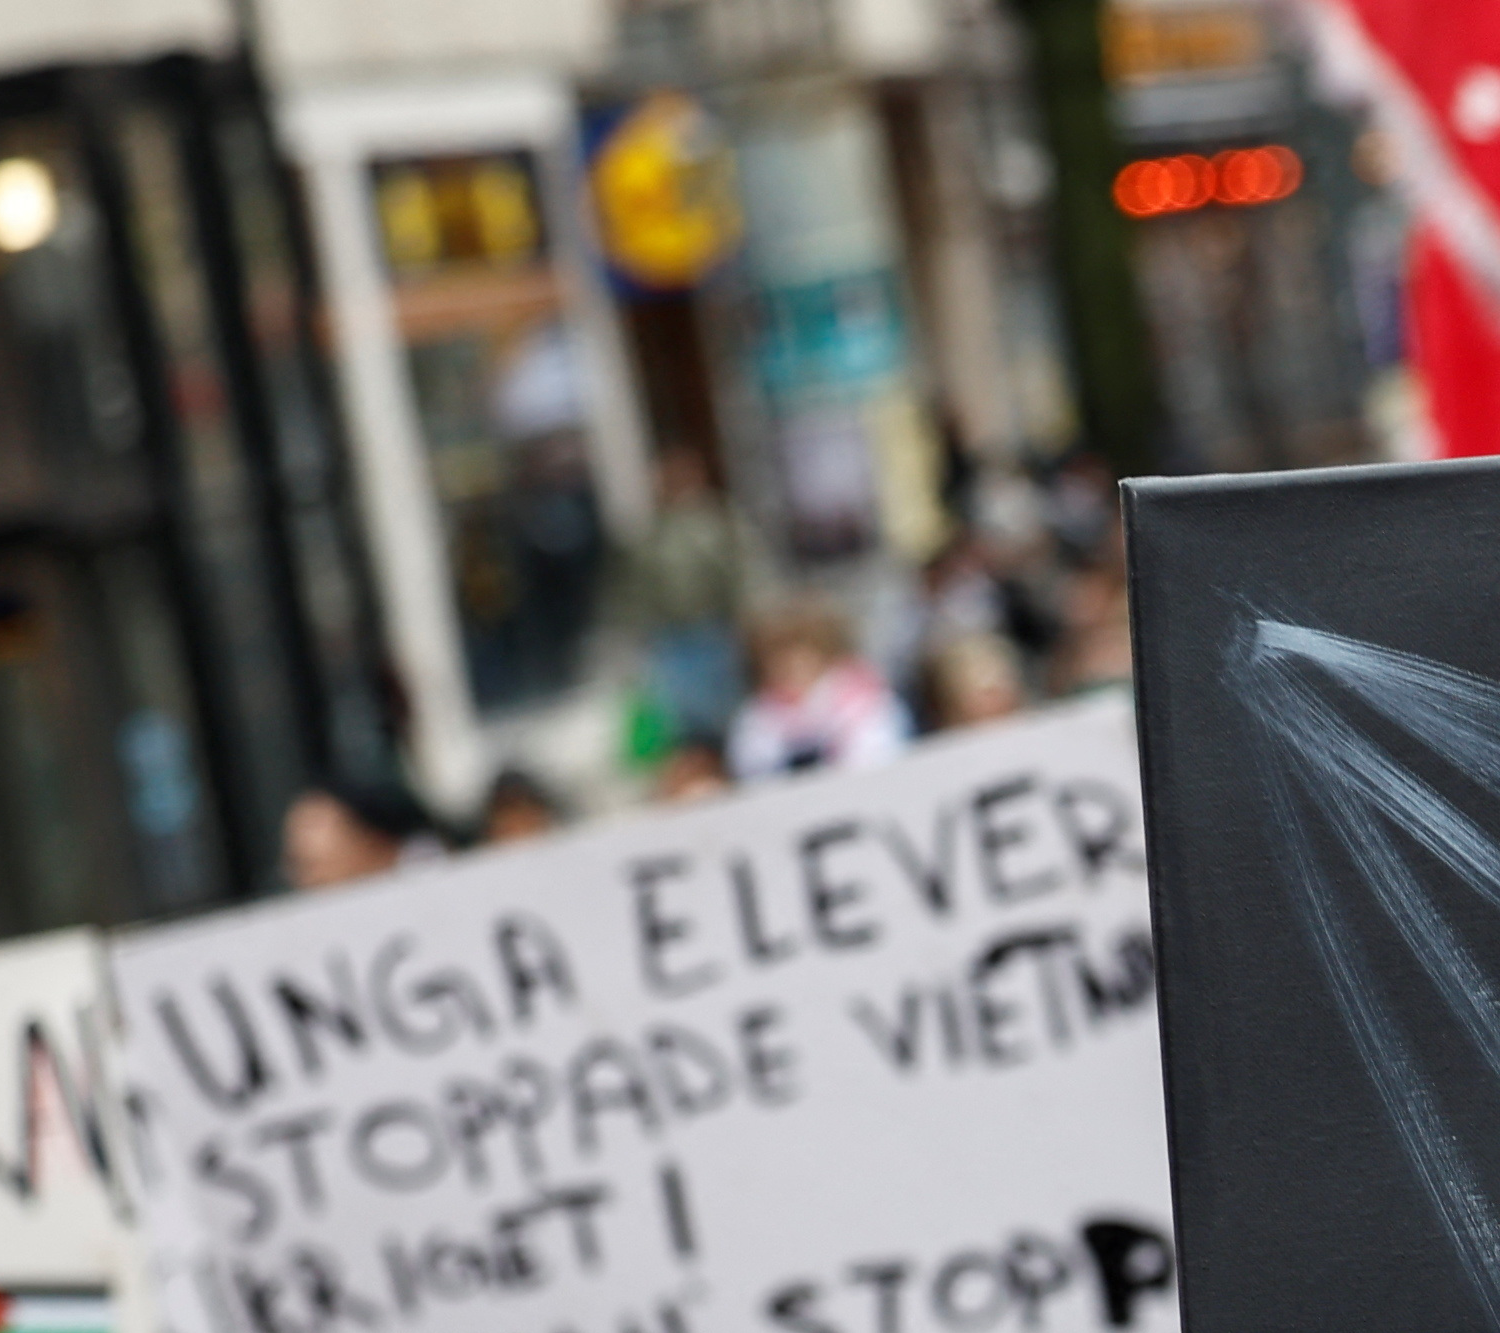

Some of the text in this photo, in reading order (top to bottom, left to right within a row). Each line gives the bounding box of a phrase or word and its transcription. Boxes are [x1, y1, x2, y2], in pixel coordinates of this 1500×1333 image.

[153, 772, 1146, 1113] UNGA ELEVER
[192, 1005, 804, 1245] STOPPADE
